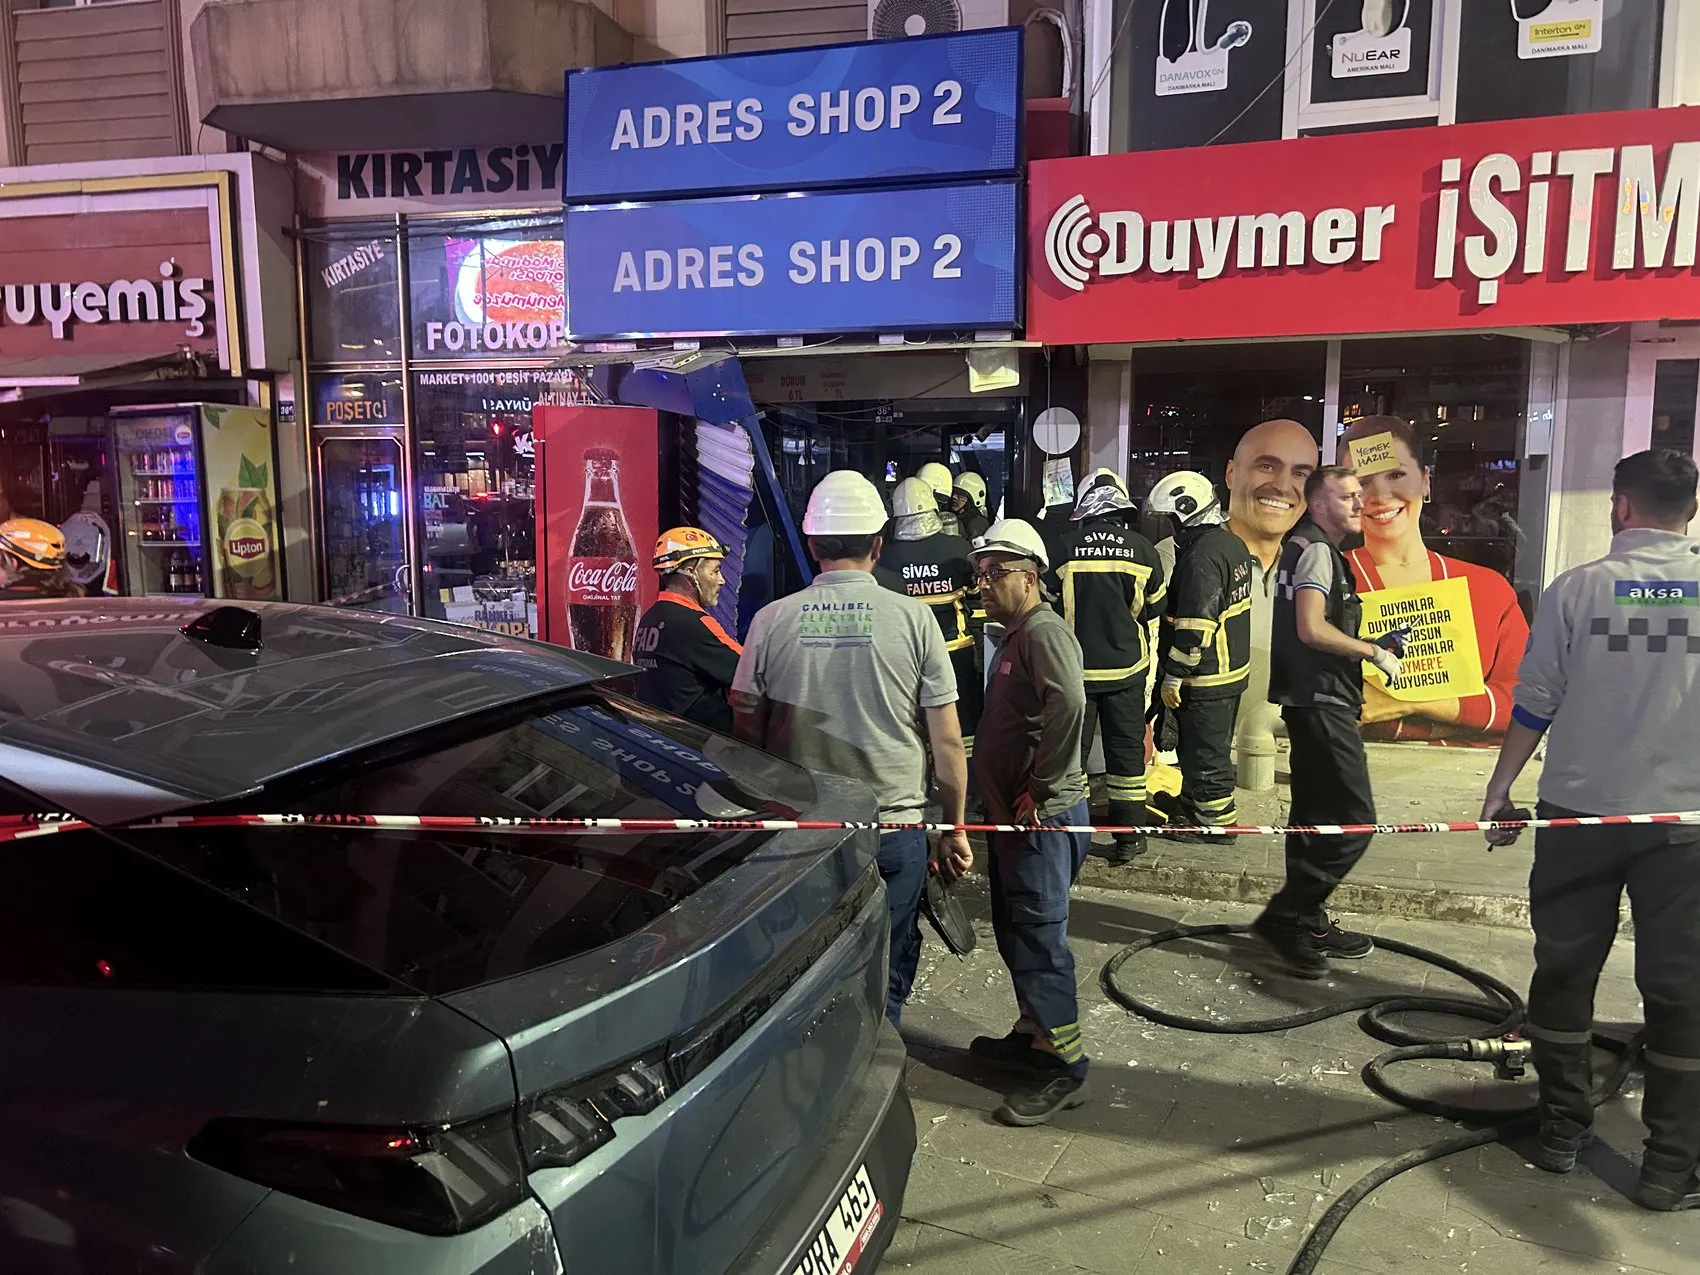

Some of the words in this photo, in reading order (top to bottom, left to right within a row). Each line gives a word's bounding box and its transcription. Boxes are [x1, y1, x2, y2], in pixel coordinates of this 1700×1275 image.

[1534, 26, 1571, 36] Interton
[1159, 69, 1211, 82] DANAVOX
[611, 97, 763, 151] ADRES
[787, 84, 920, 138] SHOP
[932, 80, 963, 126] 2
[1098, 203, 1396, 280] Duymer
[612, 242, 764, 293] ADRES
[788, 236, 920, 285] SHOP
[932, 233, 963, 280] 2
[0, 261, 206, 338] uyemiş
[427, 320, 563, 351] FOTOKOP
[1356, 442, 1391, 457] YEMEK
[1357, 452, 1395, 467] HAZIR
[1084, 531, 1125, 544] SİVAS
[232, 541, 263, 556] Lipton
[1075, 545, 1134, 558] İTFAİYESİ
[568, 561, 638, 593] Coca-Cola
[902, 563, 939, 579] SİVAS
[1629, 587, 1684, 599] aksa
[1380, 597, 1435, 617] DUYANLAR
[1368, 609, 1452, 634] DUYMAYANLARA
[1405, 640, 1455, 658] AYANLAR
[1393, 671, 1450, 690] BUYURSUN
[839, 1175, 870, 1233] 465
